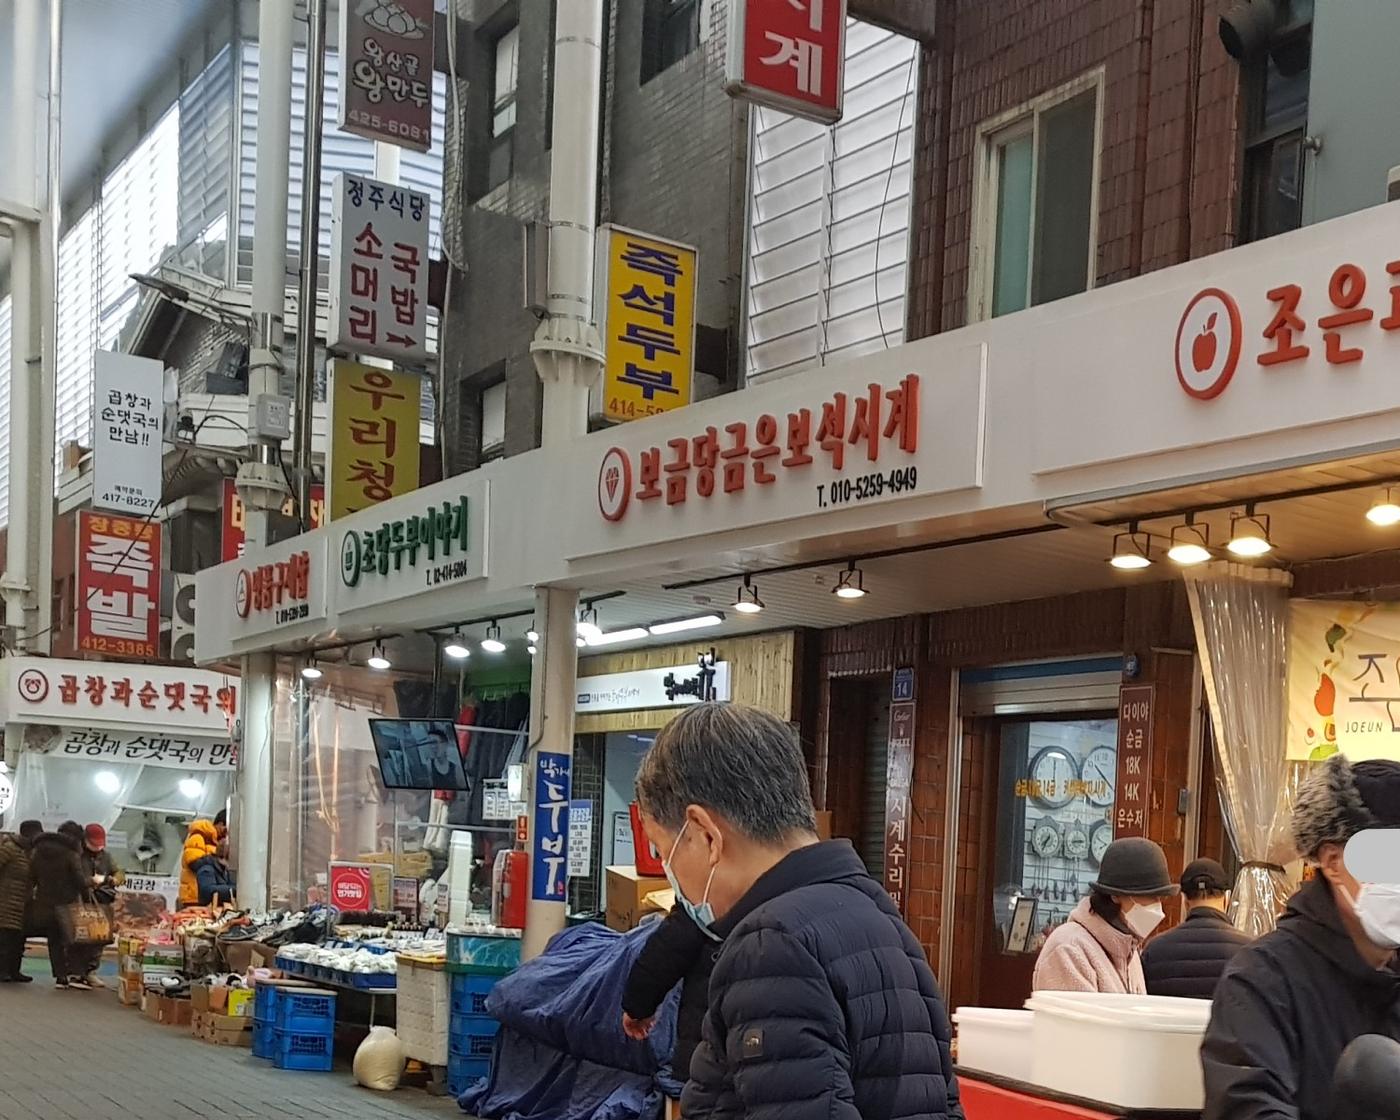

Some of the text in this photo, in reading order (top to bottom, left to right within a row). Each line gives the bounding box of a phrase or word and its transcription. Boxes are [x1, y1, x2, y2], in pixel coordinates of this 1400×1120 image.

[352, 60, 429, 108] 왕만두
[347, 109, 429, 141] 425-6081
[348, 179, 425, 222] 정주식당
[349, 221, 383, 345] 소머리
[391, 241, 420, 326] 국밥
[616, 241, 683, 401] 즉석두부
[108, 389, 152, 410] 곱창과
[101, 407, 158, 430] 순댓국의
[109, 426, 150, 446] 만남!!
[636, 374, 919, 506] 보금당금은보석시계
[831, 466, 917, 504] 010-5259-4949
[102, 492, 154, 508] 417-8227
[361, 495, 468, 576] 초당두부이야기
[86, 533, 156, 642] 족발
[81, 637, 154, 657] 412-3385
[1123, 701, 1149, 722] 다이야
[1126, 728, 1143, 749] 순금
[1345, 721, 1383, 734] JOEUN
[64, 729, 120, 756] 곱창과
[125, 735, 204, 764] 순댓국의
[1125, 755, 1141, 775] 18K
[1124, 782, 1140, 801] 14K
[1117, 809, 1143, 830] 은수저
